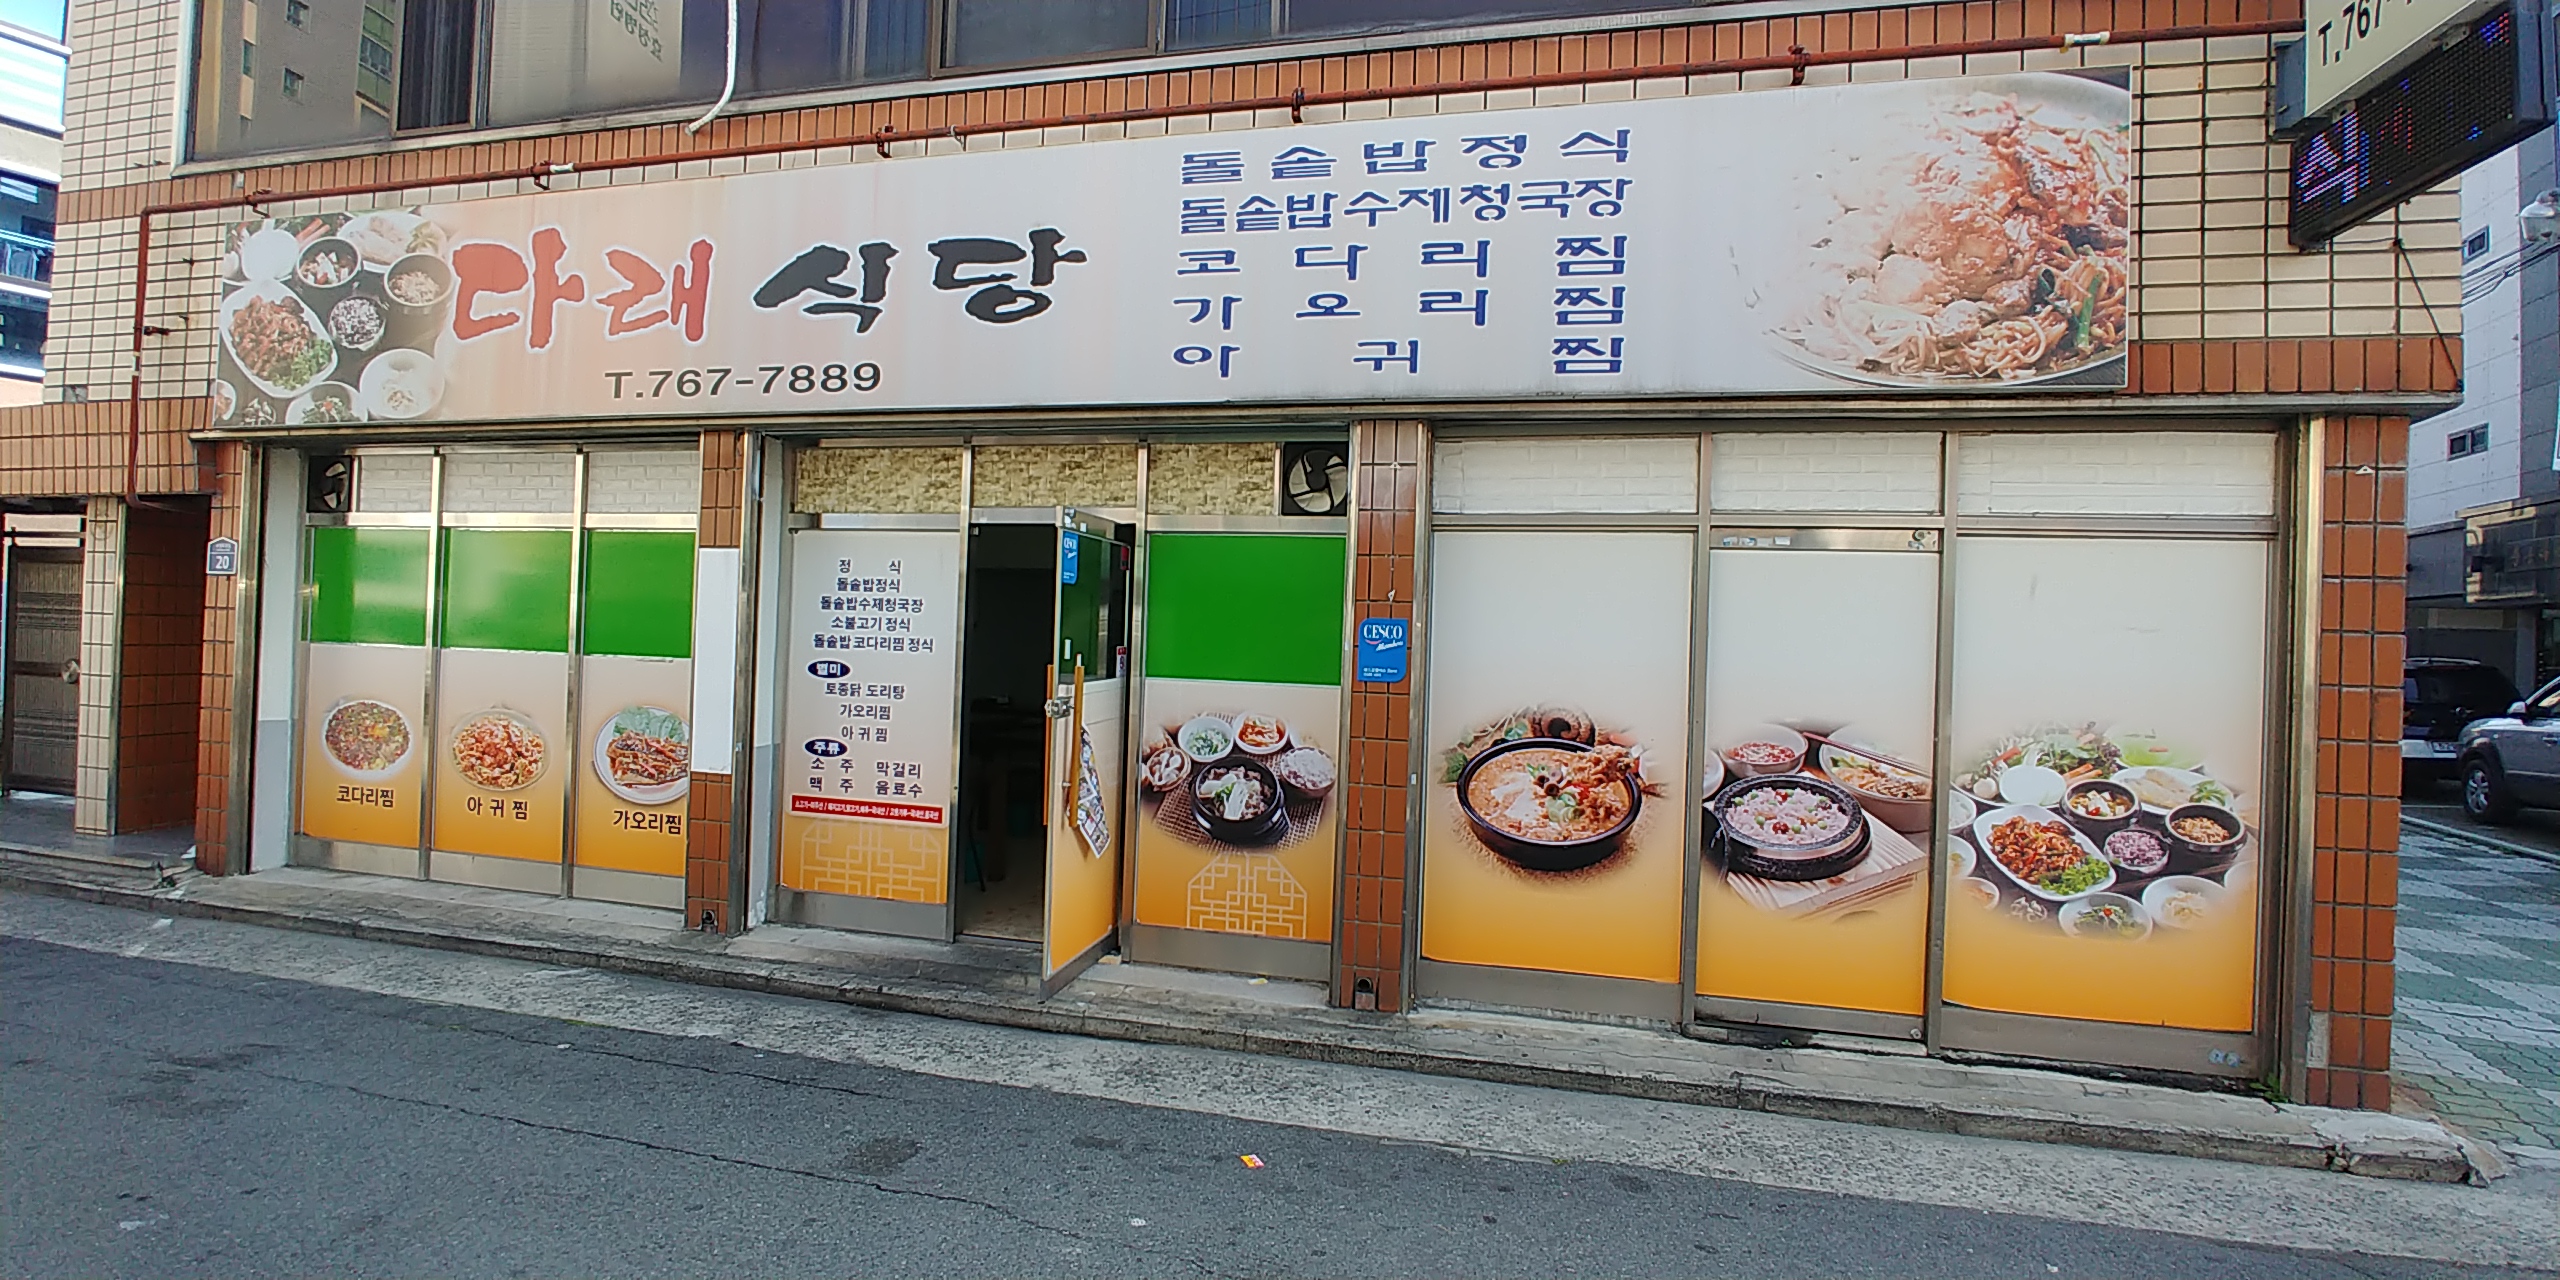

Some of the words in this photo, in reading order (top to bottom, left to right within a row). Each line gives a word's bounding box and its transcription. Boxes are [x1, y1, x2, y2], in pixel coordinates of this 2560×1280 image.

[1180, 178, 1633, 234] 돌솥밥수제청국장
[453, 228, 714, 350] 다래
[753, 228, 1088, 334] 식당
[605, 362, 882, 399] T.767-7889
[215, 555, 230, 570] 20
[837, 577, 901, 593] 돌솥밥정식
[885, 617, 911, 632] 정식
[1363, 624, 1403, 639] CESCO
[908, 638, 934, 653] 정식
[825, 682, 862, 697] 토종닭
[866, 685, 905, 700] 도리탕
[840, 704, 891, 720] 가오리찜
[876, 761, 922, 779] 막걸리
[336, 785, 395, 808] 코다리찜
[875, 780, 923, 799] 음료수
[612, 810, 683, 835] 가오리찜
